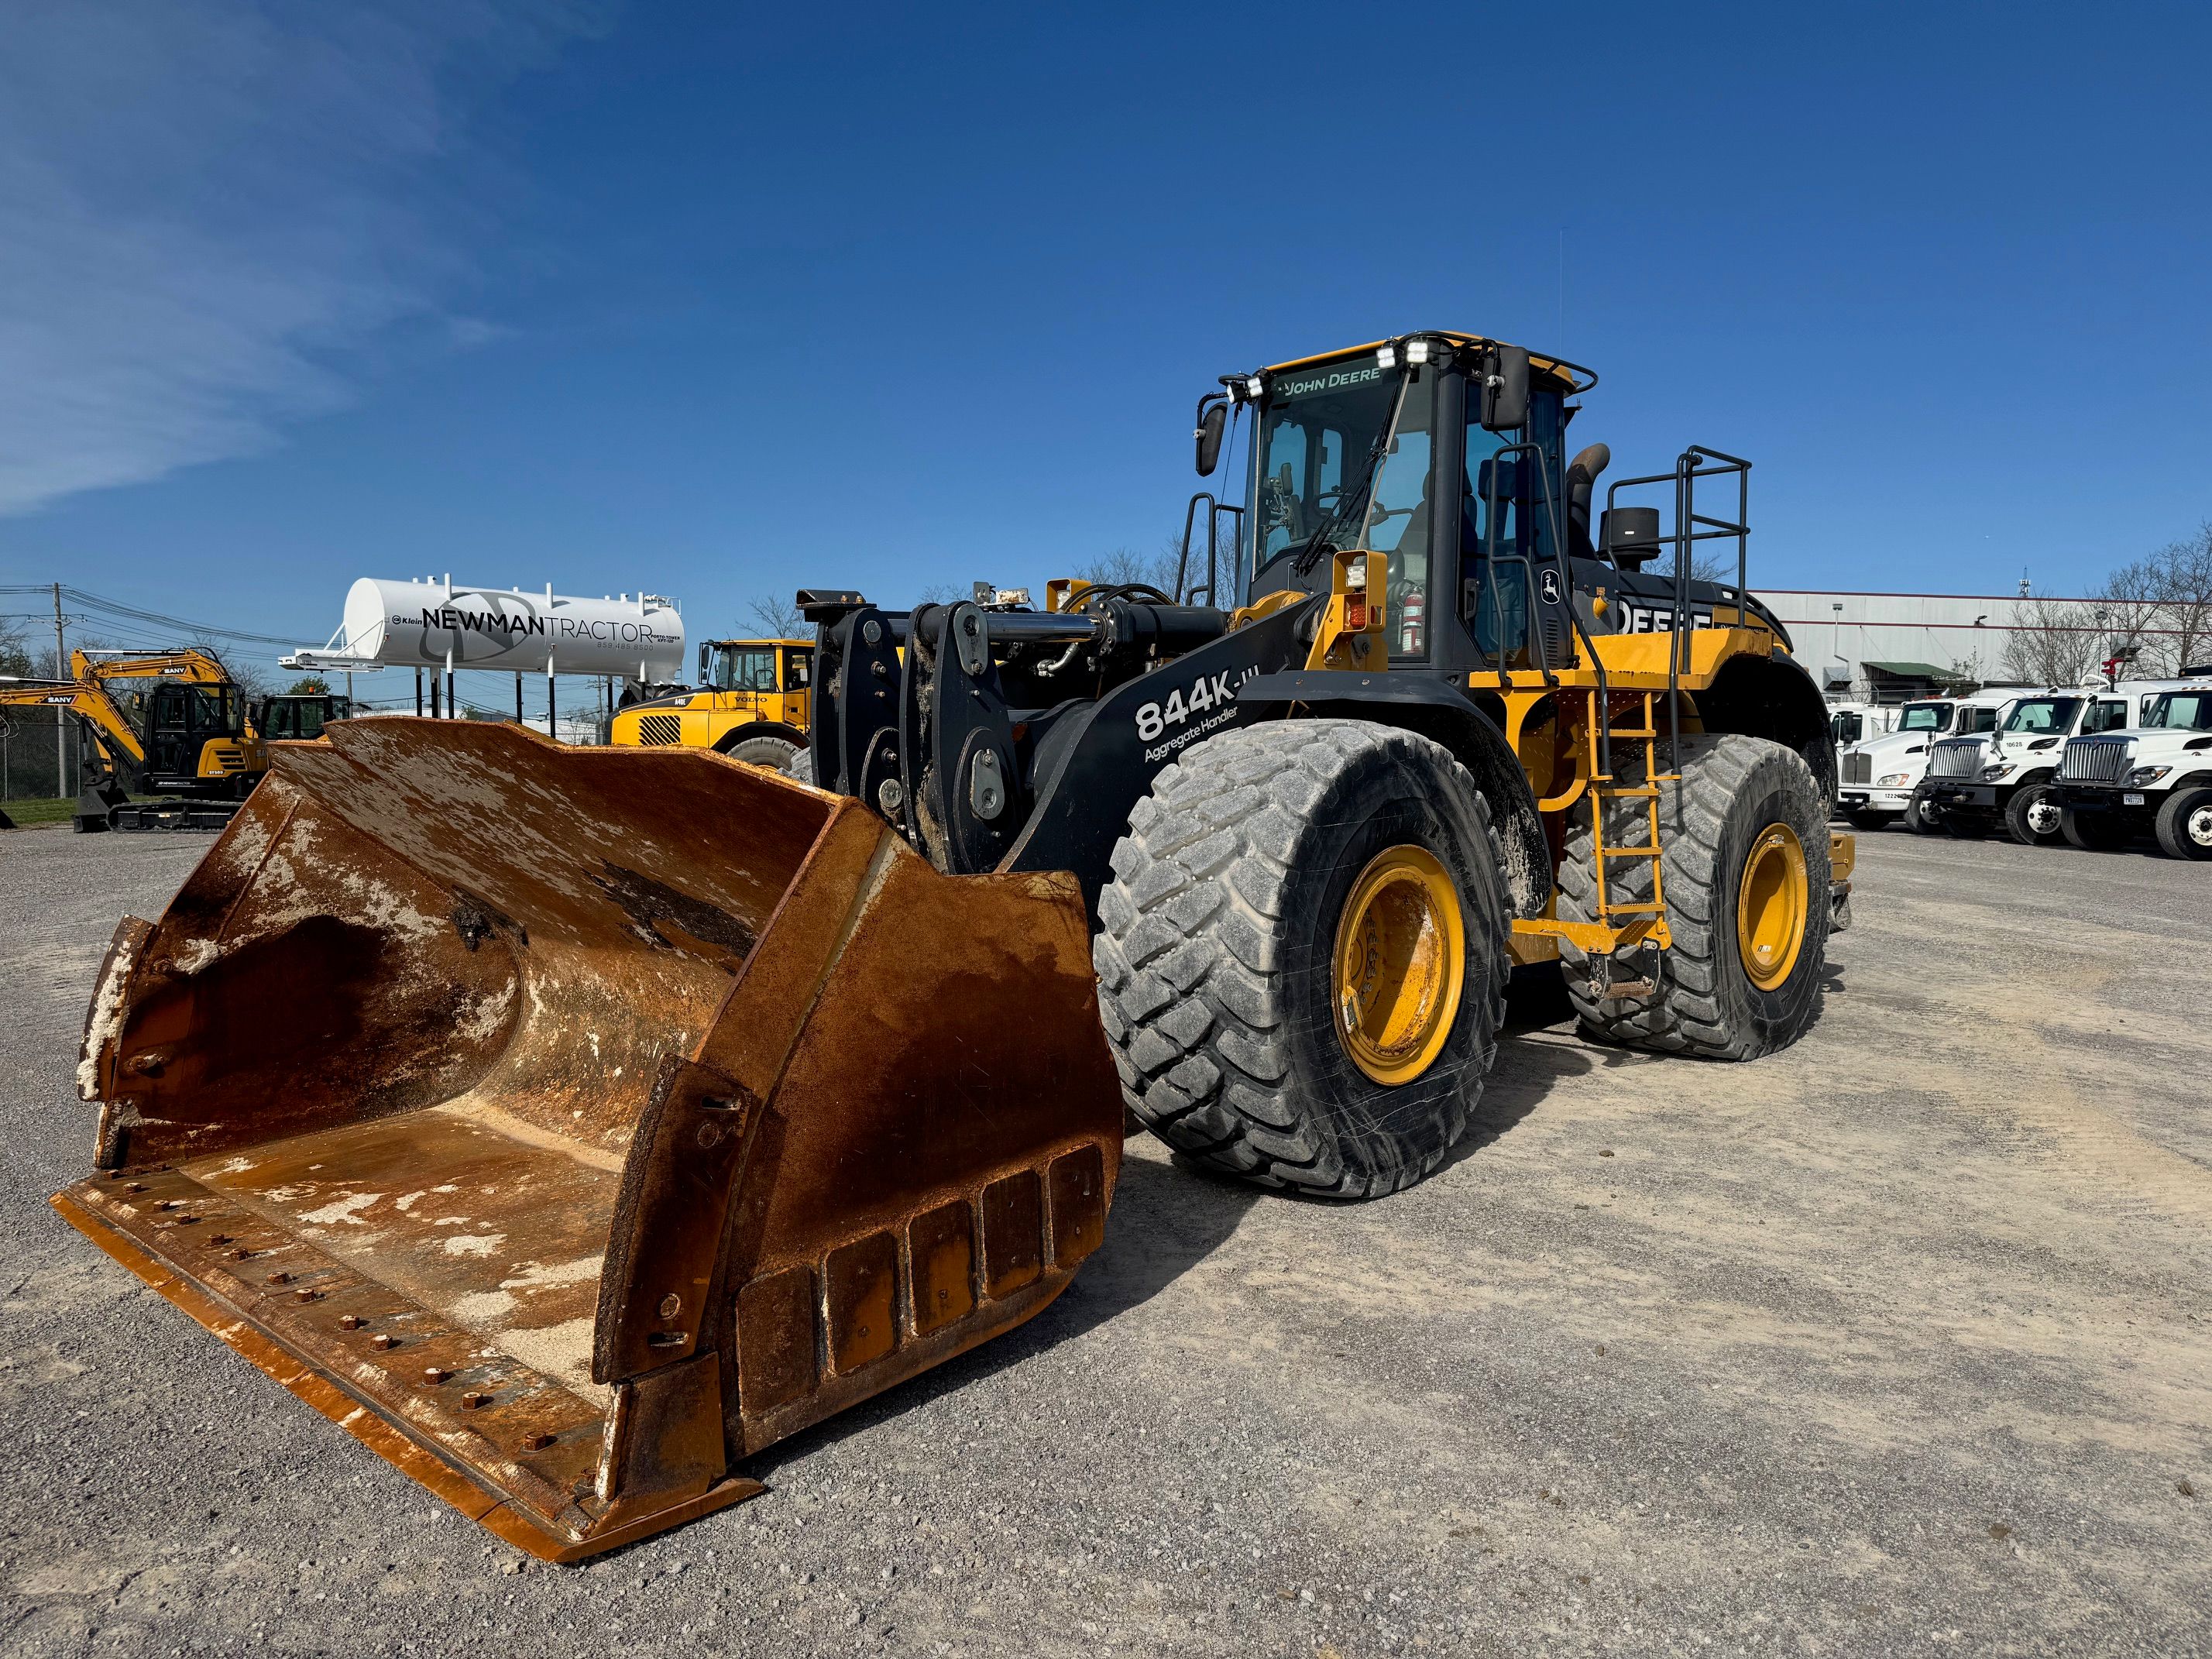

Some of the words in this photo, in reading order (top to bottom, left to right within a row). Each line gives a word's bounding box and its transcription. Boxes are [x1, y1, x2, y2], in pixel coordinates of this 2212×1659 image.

[1285, 378, 1326, 397] JOHN
[1328, 367, 1380, 387] DEERE
[1145, 726, 1200, 764] Aggregate
[1200, 706, 1238, 733] Handler
